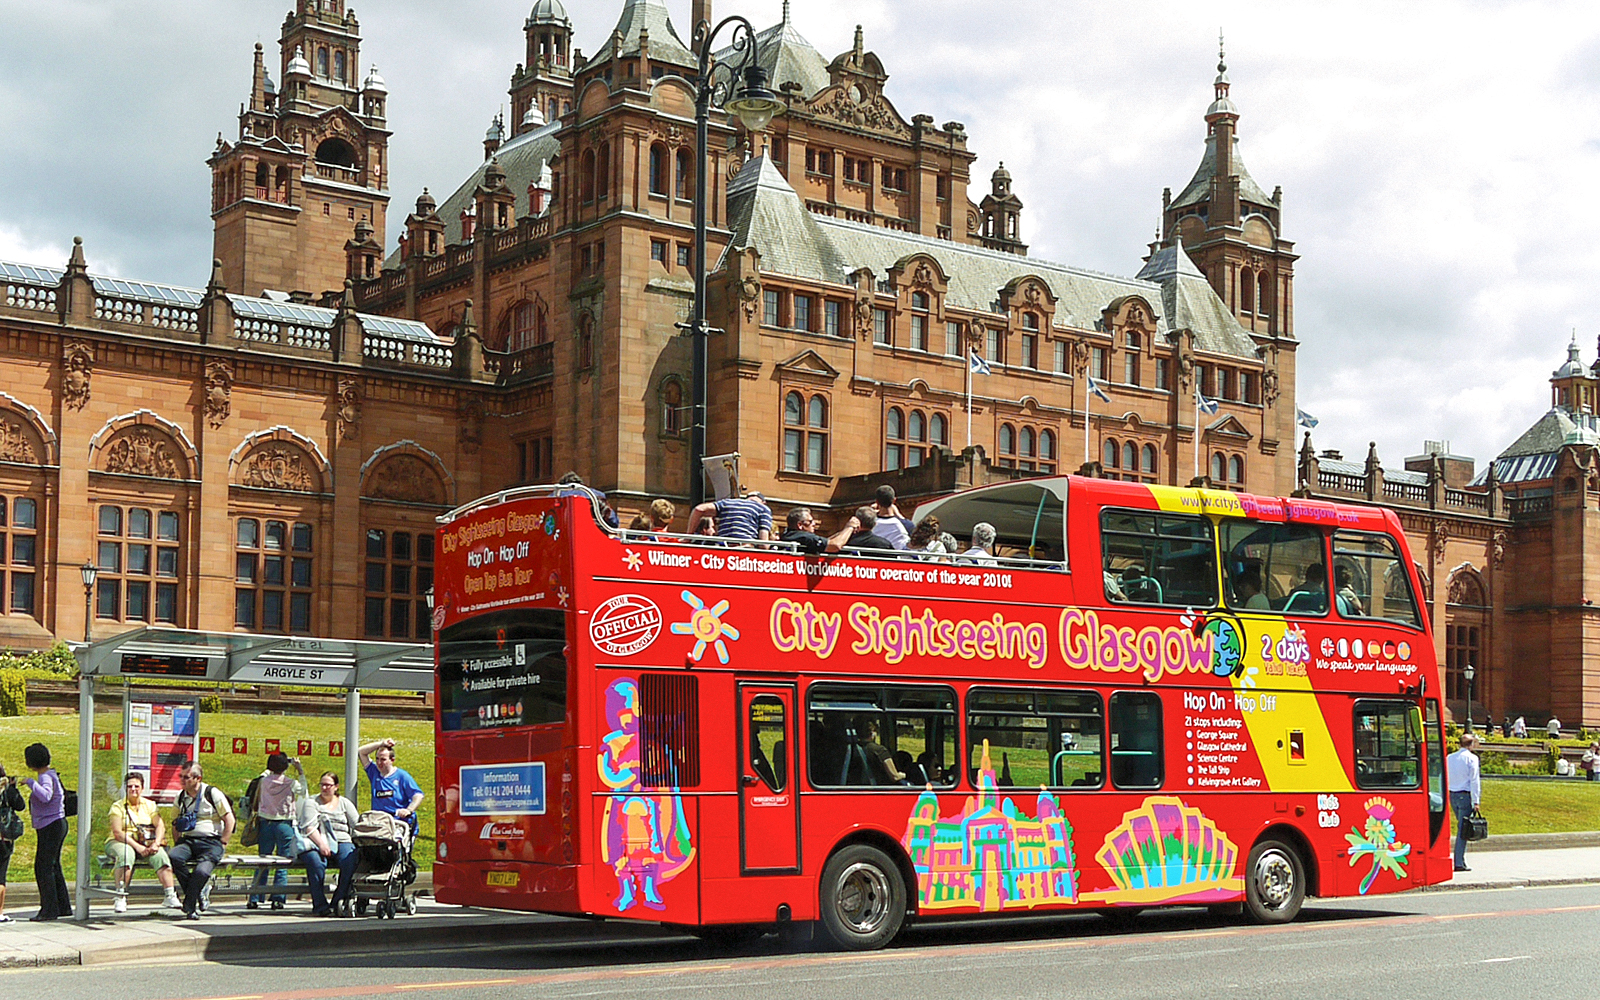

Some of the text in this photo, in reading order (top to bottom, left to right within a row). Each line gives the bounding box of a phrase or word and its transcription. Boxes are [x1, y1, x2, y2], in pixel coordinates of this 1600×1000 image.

[442, 511, 541, 554] City Sightseeing Glasgow
[467, 551, 482, 568] Hop
[484, 547, 494, 564] On
[500, 545, 515, 563] Hop
[516, 541, 530, 559] Off
[648, 550, 692, 568] Winner
[701, 556, 725, 574] City
[727, 558, 795, 577] Sightseeing
[796, 560, 853, 579] Worldwide
[855, 564, 877, 580] tour
[880, 567, 925, 585] operator
[927, 569, 939, 581] of
[940, 569, 957, 584] the
[958, 573, 981, 588] year
[983, 574, 1012, 588] 2010!
[464, 566, 533, 595] Open Top Bus Tour
[607, 597, 629, 609] TOUR
[594, 611, 659, 639] OFFICIAL
[606, 631, 654, 654] OF GLASGOW
[770, 598, 1216, 684] City Sightseeing Glasgow
[1260, 633, 1312, 666] 2 days
[469, 655, 513, 672] Fully accessible
[1316, 658, 1418, 675] We speak your language
[263, 667, 324, 680] ARGYLE ST
[470, 672, 541, 691] Available for private hire
[1184, 691, 1206, 713] Hop
[1209, 691, 1226, 710] On
[1234, 693, 1257, 714] Hop
[1259, 693, 1277, 712] Off
[1185, 716, 1243, 729] 21 stops including:
[1197, 730, 1239, 741] George Square
[1197, 741, 1220, 752] Glasgow
[1197, 753, 1219, 763] Science
[483, 771, 520, 783] Information
[1198, 765, 1208, 775] The
[484, 786, 500, 798] 0141
[501, 785, 514, 797] 204
[514, 784, 531, 796] 0444
[1317, 793, 1340, 811] Kids
[1318, 811, 1340, 828] Club
